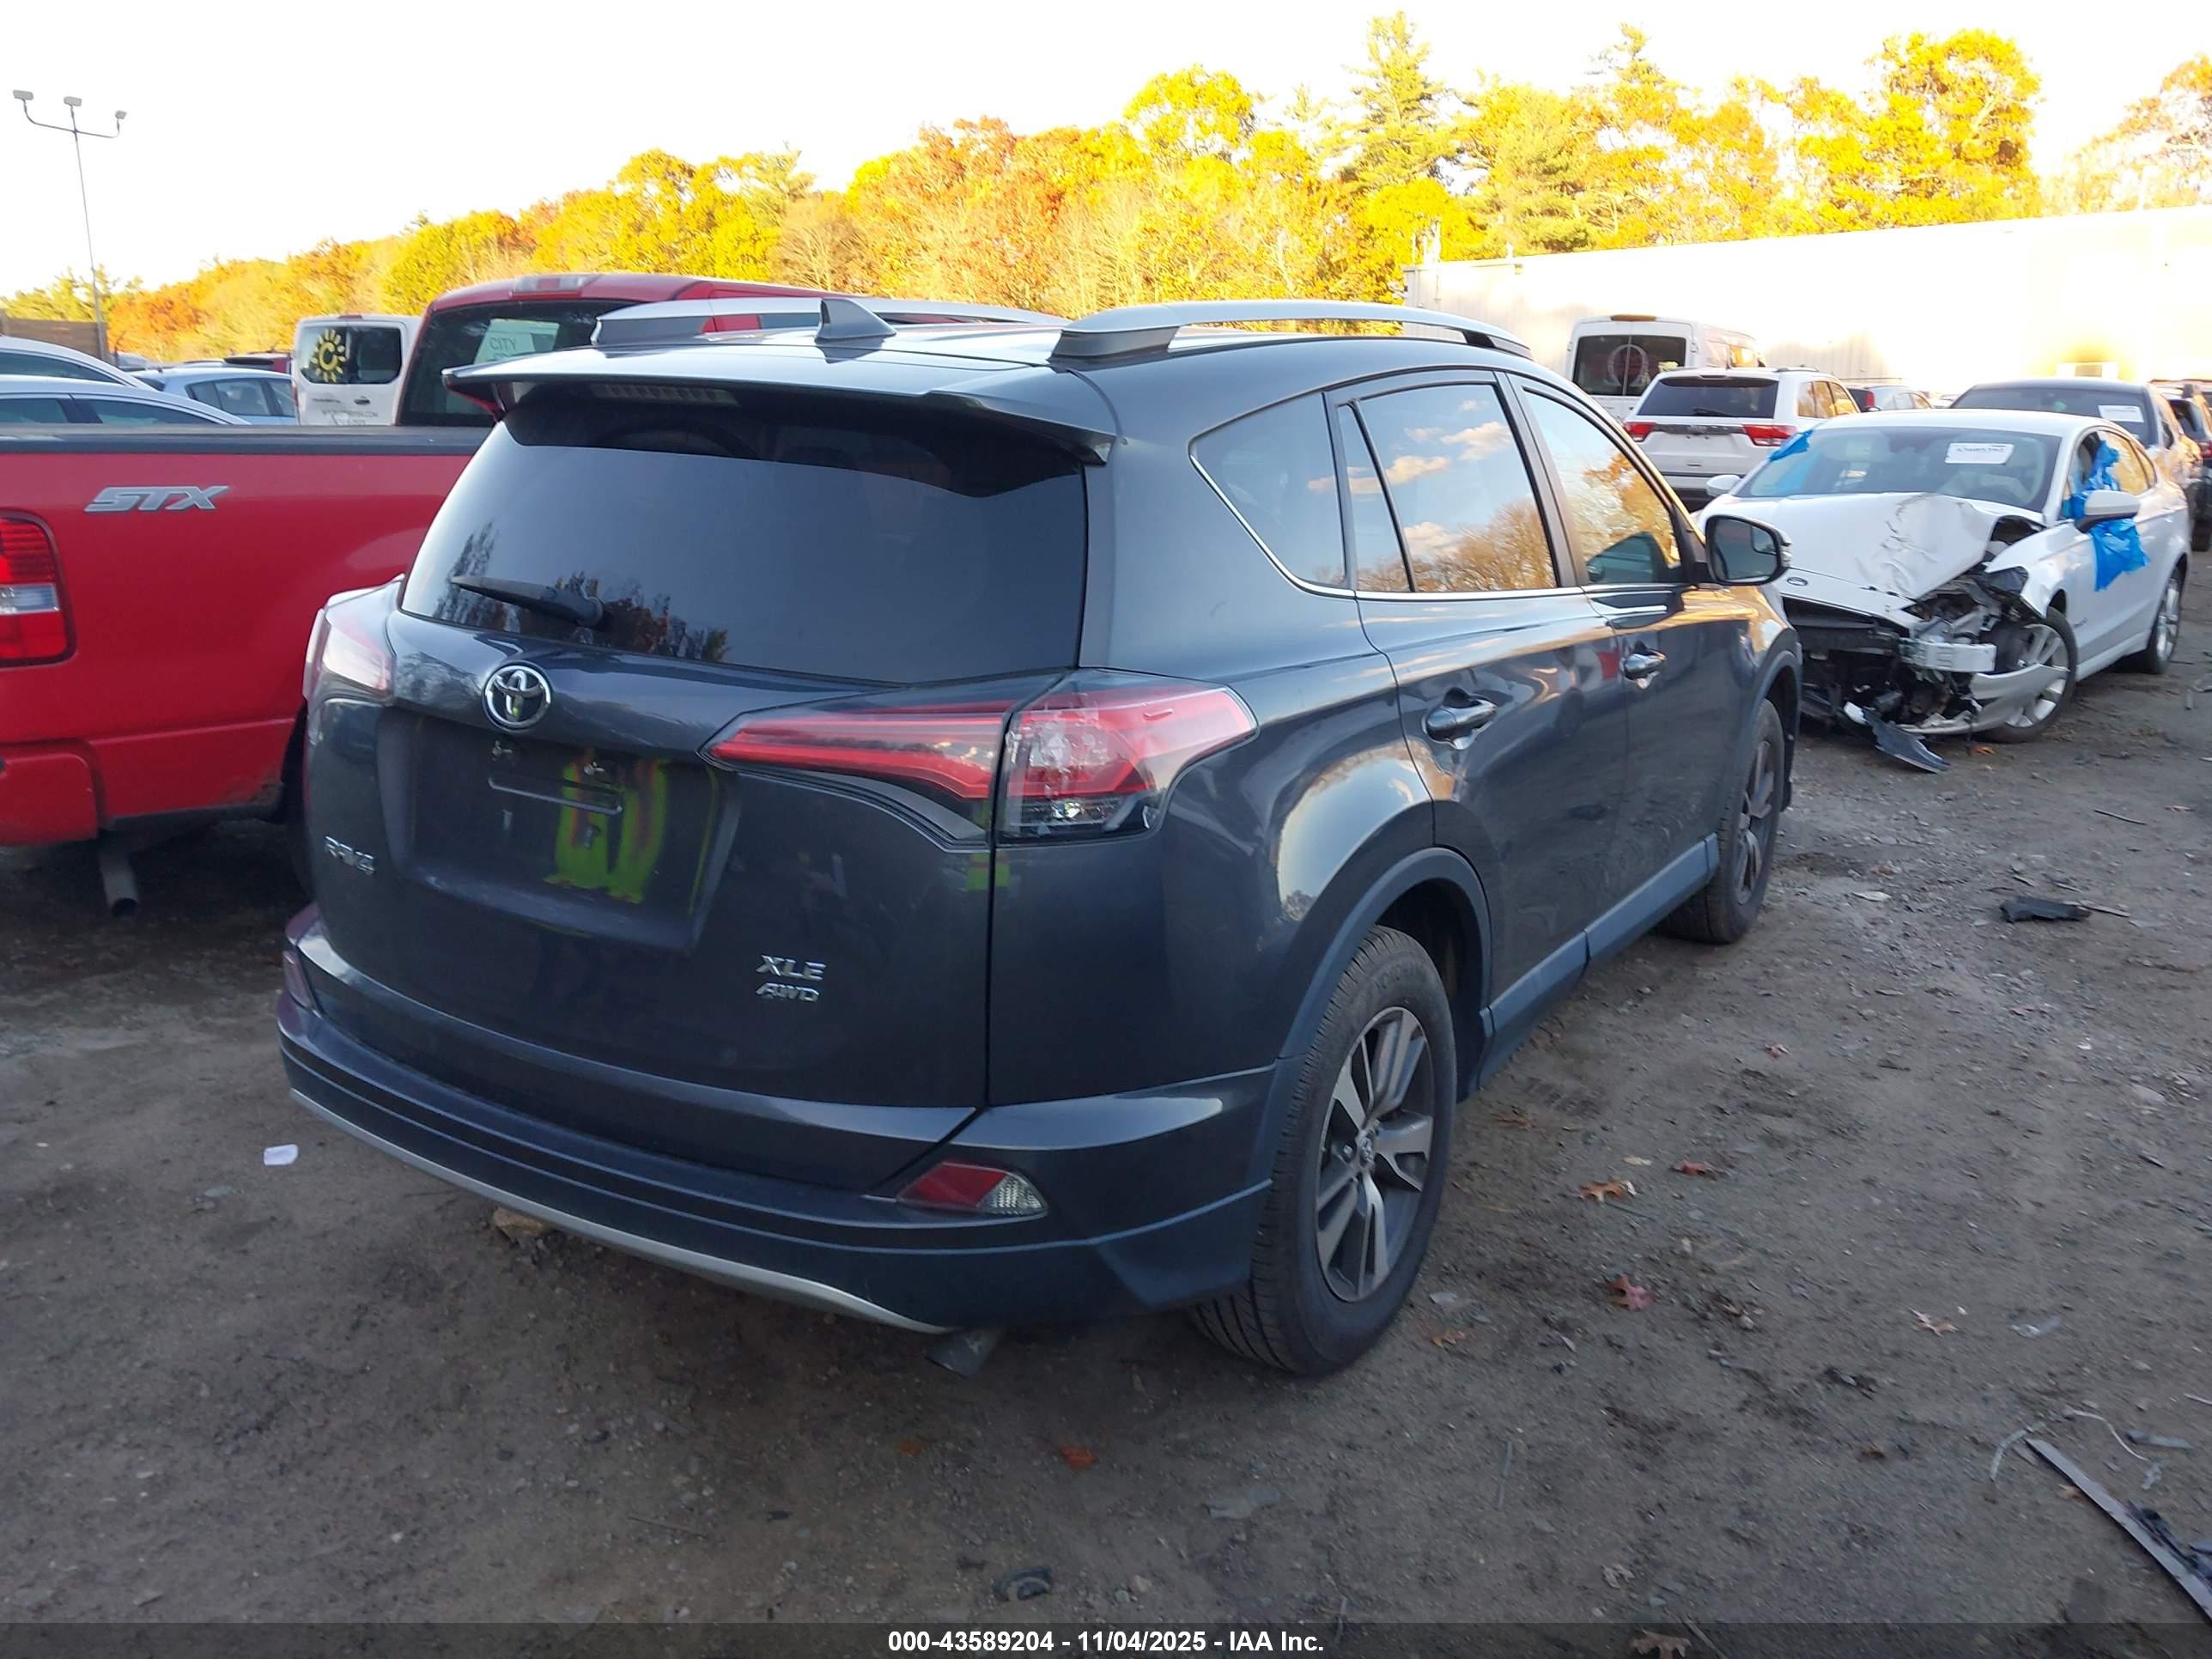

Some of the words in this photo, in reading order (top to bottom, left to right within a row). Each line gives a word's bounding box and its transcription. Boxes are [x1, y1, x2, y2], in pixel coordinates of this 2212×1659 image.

[84, 484, 230, 513] STX
[325, 836, 375, 876] RAV4
[756, 954, 827, 981] XLE
[756, 982, 820, 1002] AWD
